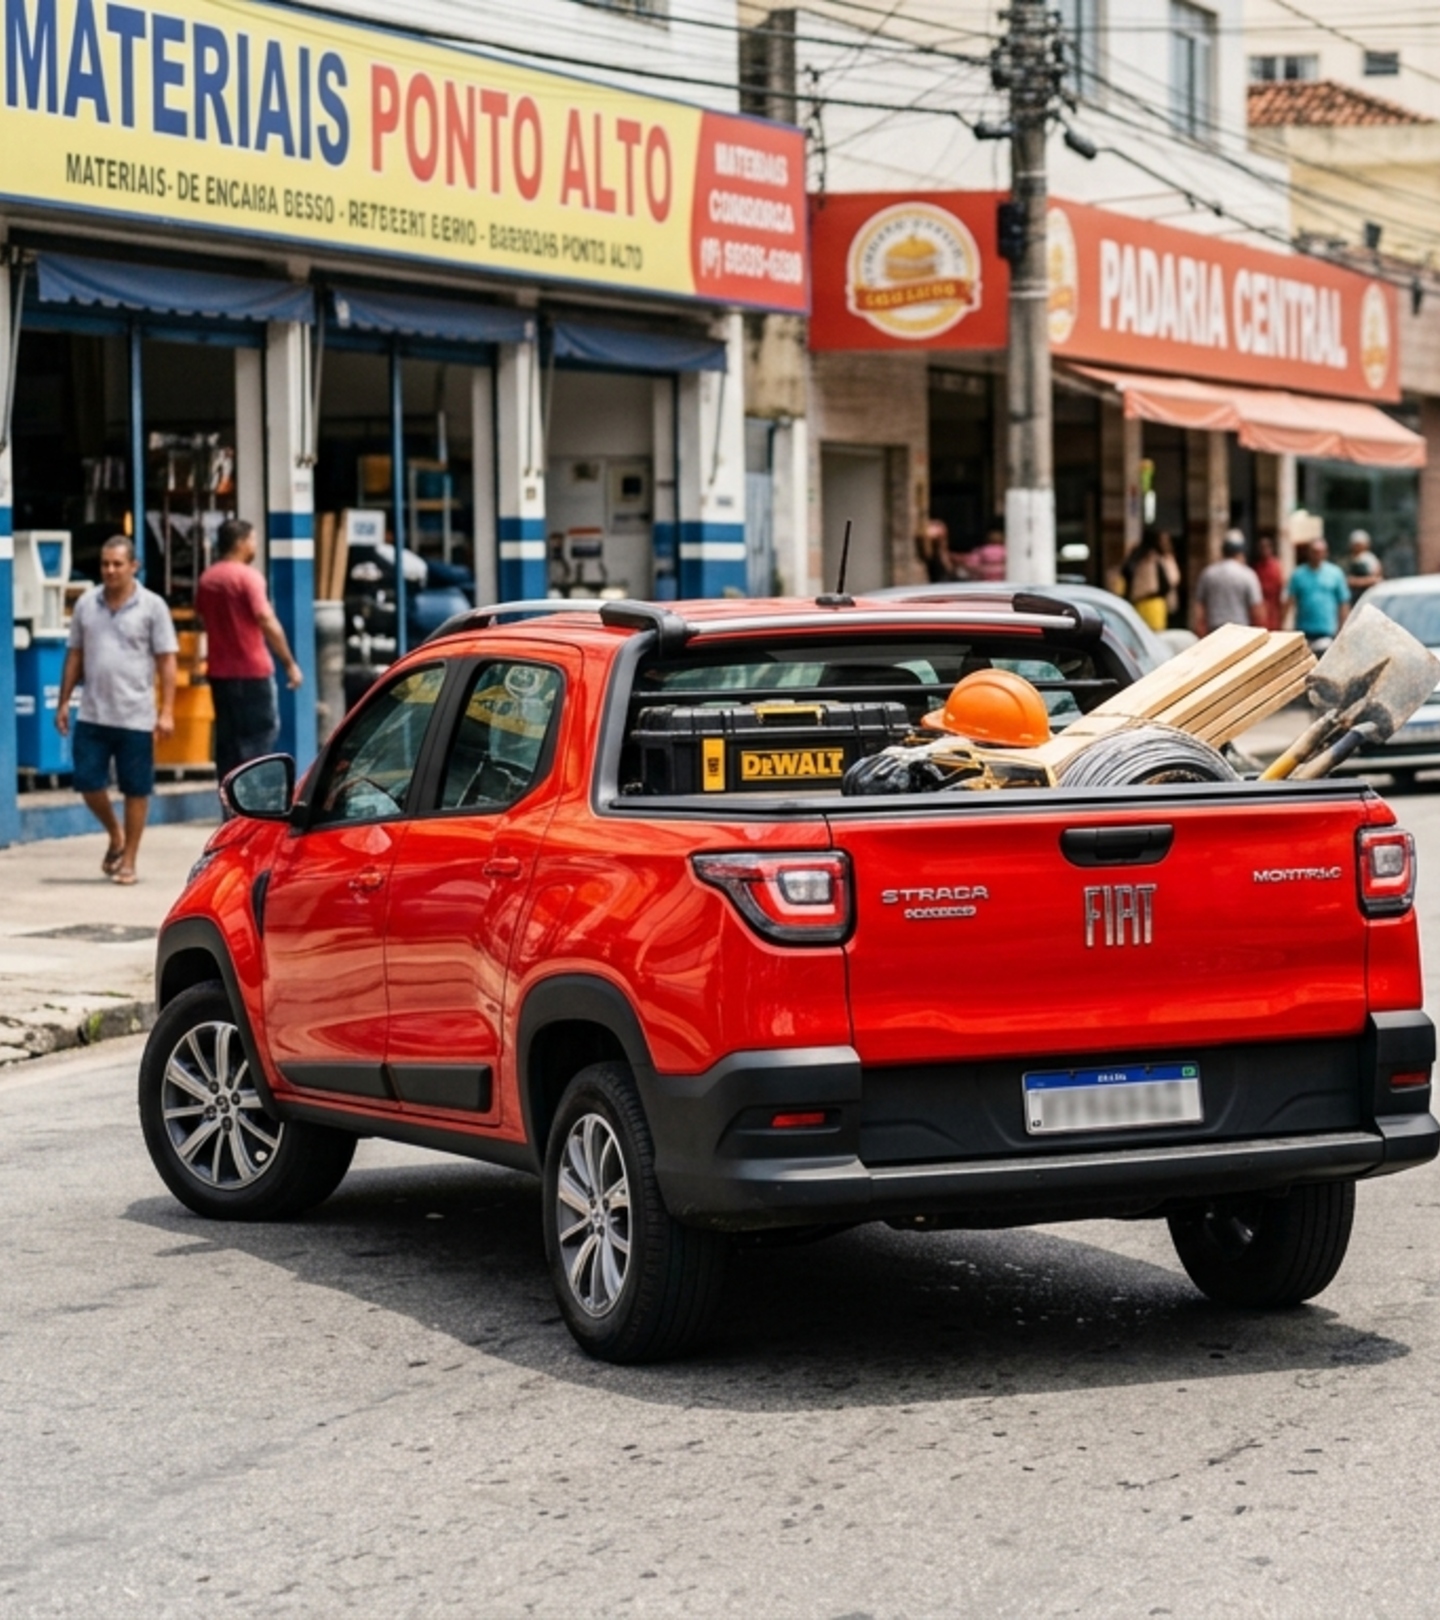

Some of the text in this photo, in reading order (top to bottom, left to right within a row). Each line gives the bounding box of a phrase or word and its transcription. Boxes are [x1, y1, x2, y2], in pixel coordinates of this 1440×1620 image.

[5, 0, 673, 223] MATERIAIS PONTO ALTO
[177, 171, 200, 202] DE
[1099, 238, 1348, 370] PADARIA CENTRAL
[1084, 883, 1156, 948] FIAT
